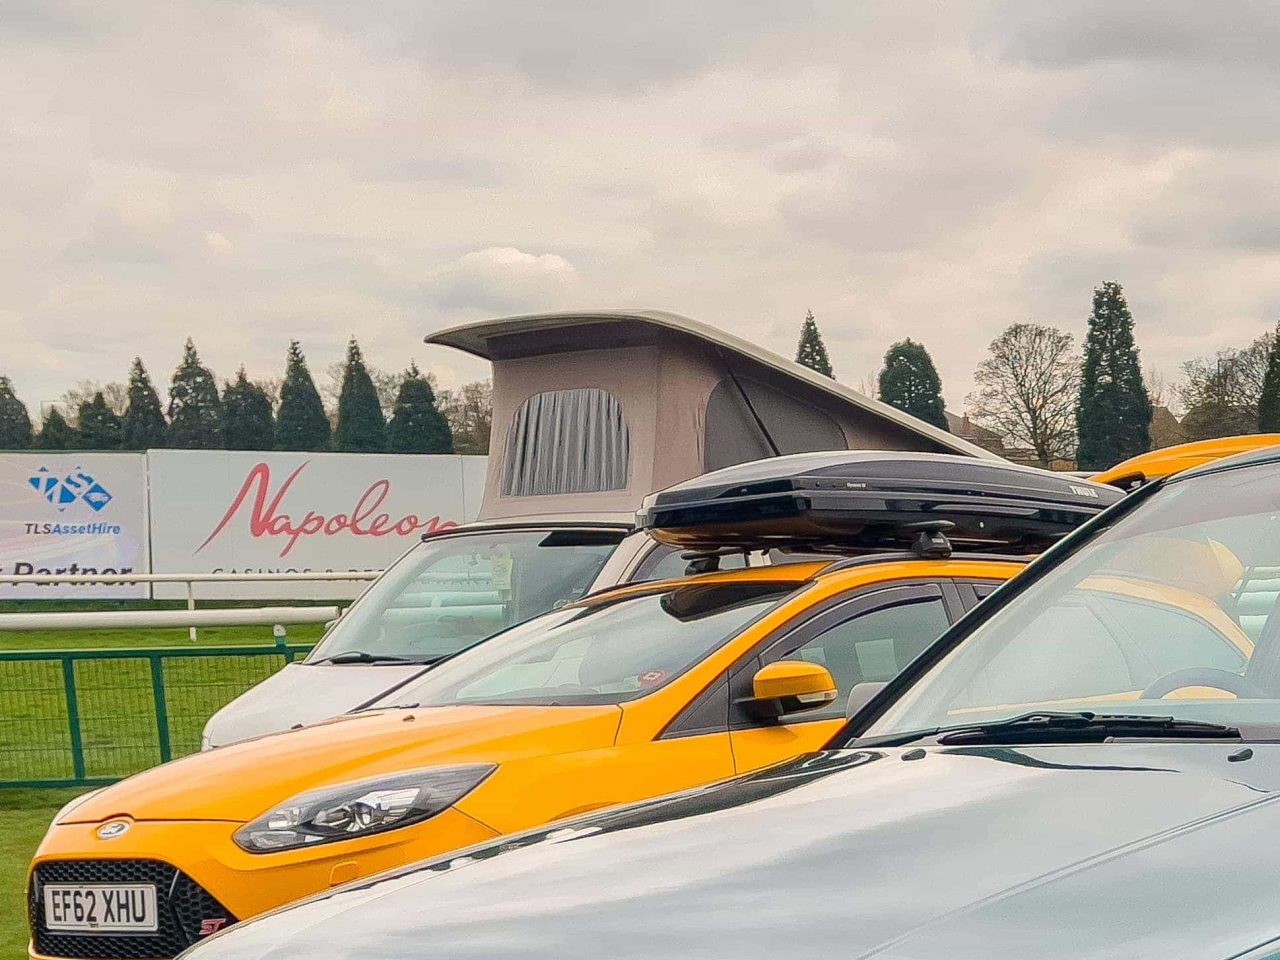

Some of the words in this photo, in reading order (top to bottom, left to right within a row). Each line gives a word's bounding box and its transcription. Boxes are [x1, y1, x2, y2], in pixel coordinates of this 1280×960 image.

[52, 890, 97, 922] EF62
[102, 890, 146, 923] XHU
[199, 918, 226, 935] ST
